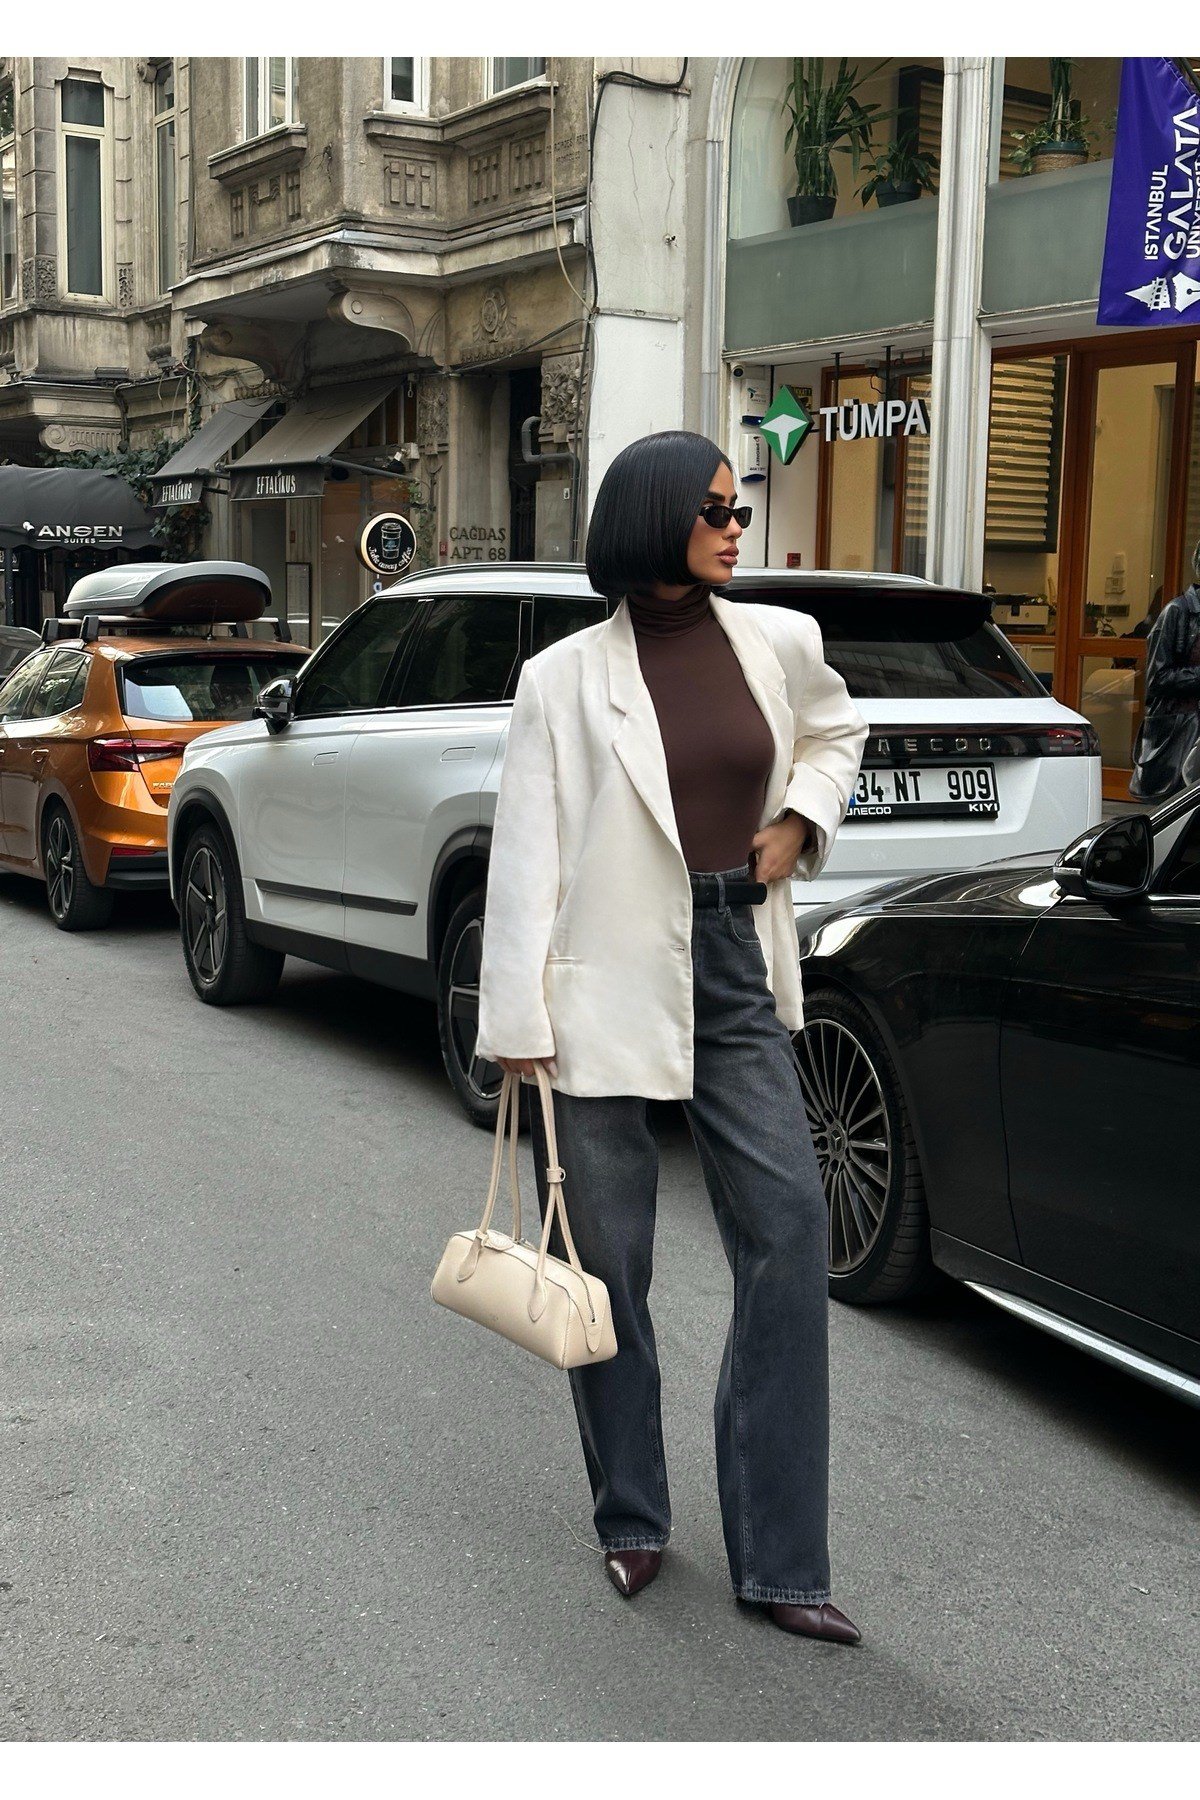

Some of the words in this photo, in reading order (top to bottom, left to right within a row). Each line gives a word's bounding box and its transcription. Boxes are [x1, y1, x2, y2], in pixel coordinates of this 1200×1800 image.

[1163, 106, 1200, 260] GALATA
[819, 399, 928, 442] TÜMPA
[488, 547, 507, 561] 68
[878, 738, 991, 751] AECOO
[856, 772, 884, 803] 34
[893, 771, 921, 802] NT
[947, 769, 991, 800] 909
[968, 802, 998, 812] KIYI
